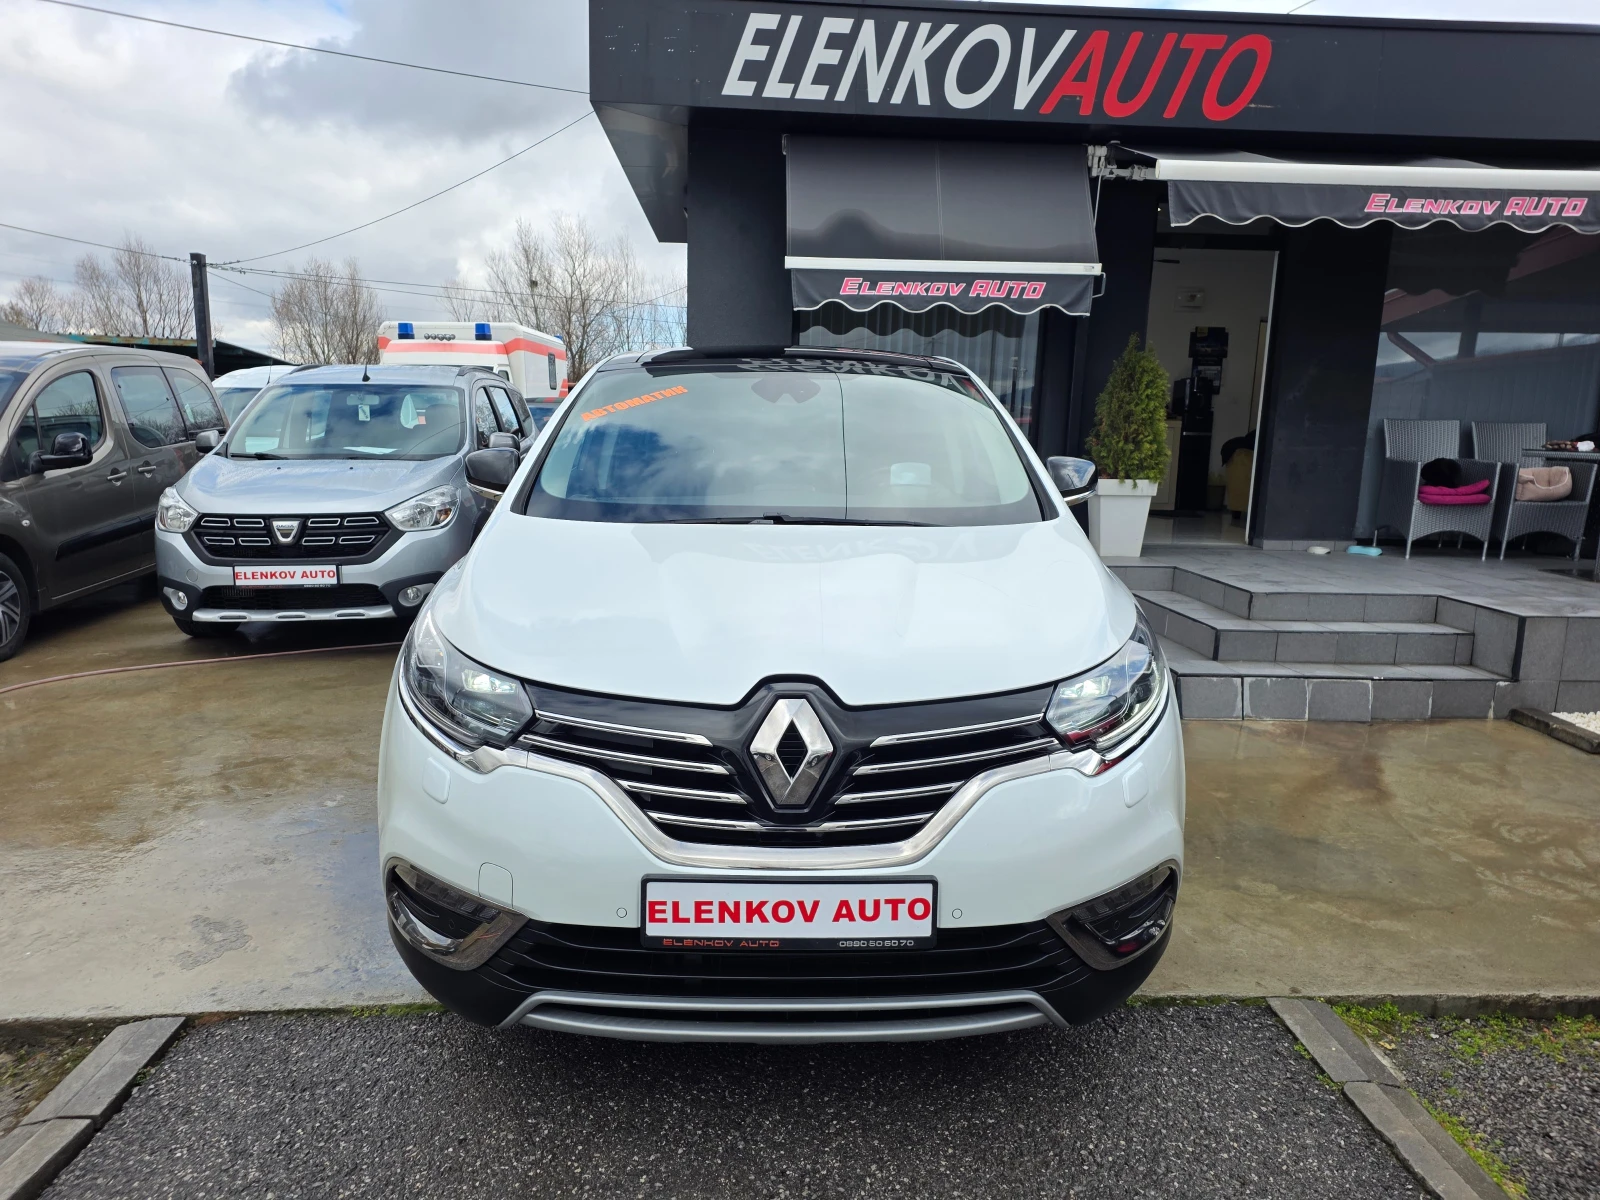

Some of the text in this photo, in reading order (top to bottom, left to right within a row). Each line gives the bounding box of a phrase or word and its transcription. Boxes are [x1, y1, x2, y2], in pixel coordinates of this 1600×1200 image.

[1364, 193, 1589, 217] ELENKOV AUTO
[839, 277, 1046, 299] ELENKOV AUTO
[235, 569, 336, 581] ELENKOV AUTO
[648, 897, 931, 924] ELENKOV AUTO
[663, 938, 780, 948] ELENKOV AUTO
